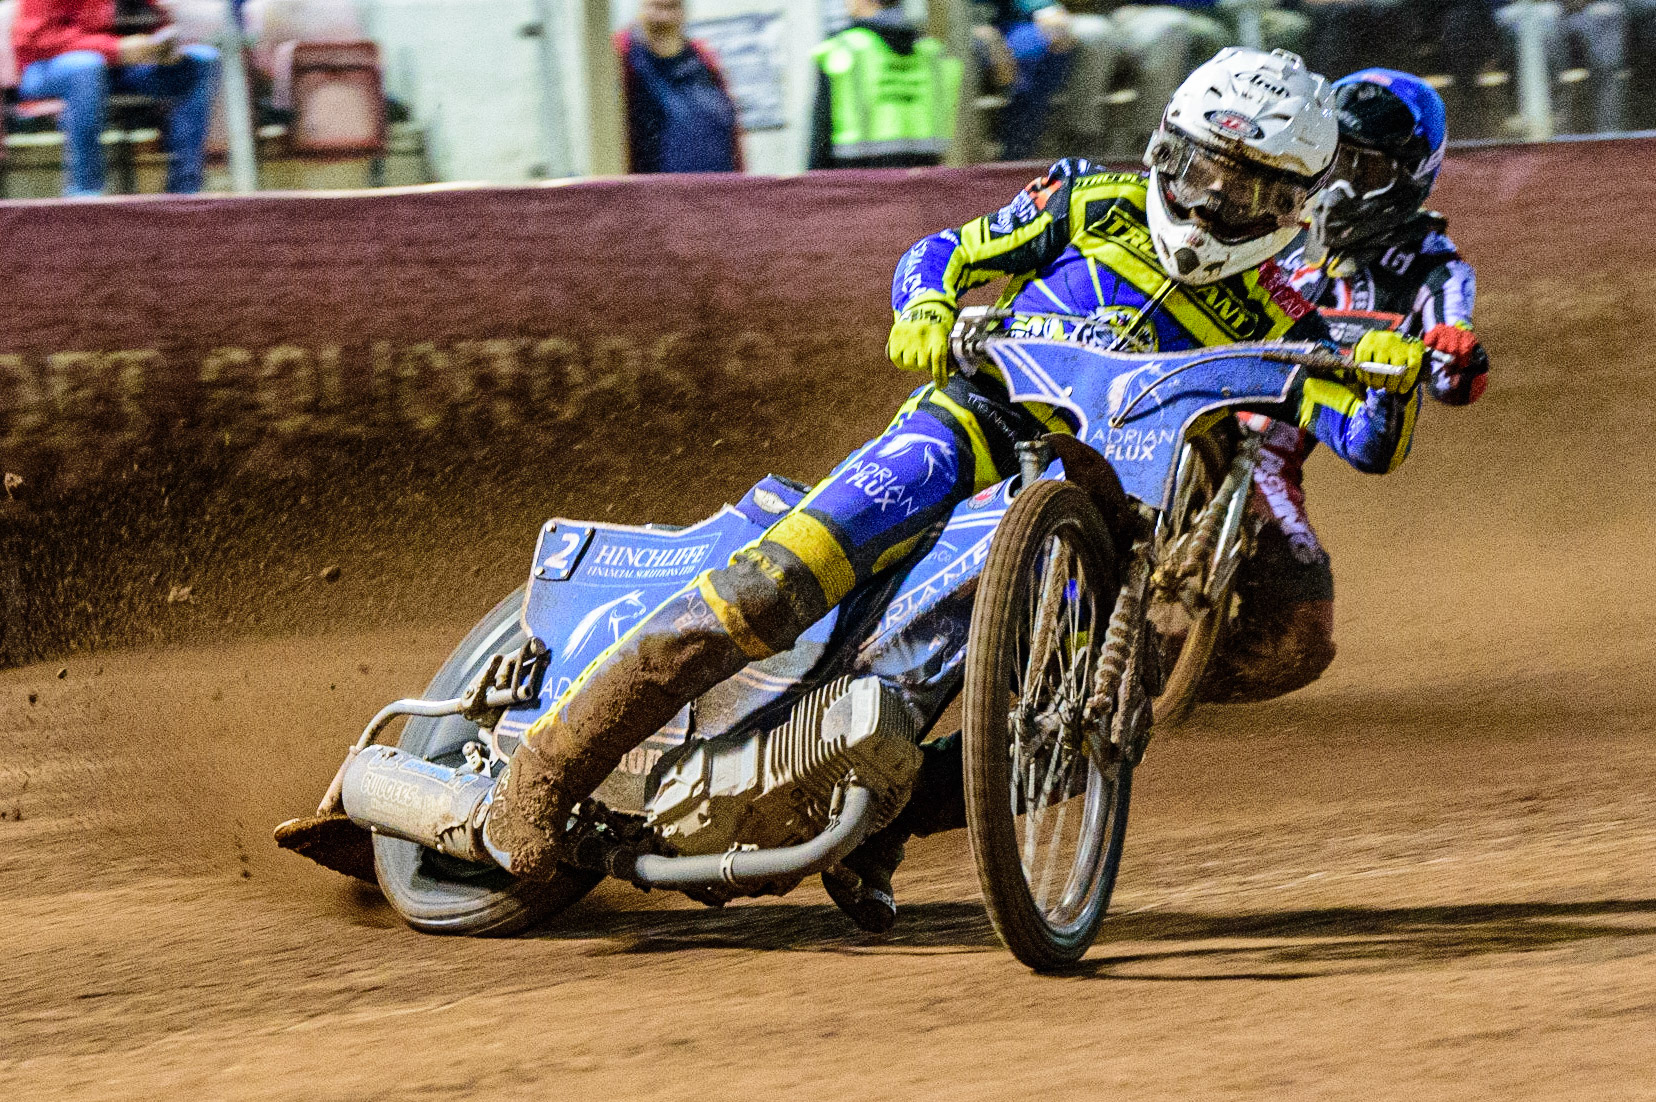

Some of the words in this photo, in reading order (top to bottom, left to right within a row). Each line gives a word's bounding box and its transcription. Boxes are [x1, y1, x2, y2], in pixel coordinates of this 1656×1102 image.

[1089, 428, 1176, 445] ADRIAN
[1104, 442, 1156, 461] FLUX
[845, 472, 897, 512] FLUX
[846, 460, 920, 516] ADRIAN
[543, 532, 580, 570] 2
[593, 543, 710, 568] HINCHLIFFE
[587, 566, 634, 579] FINANCIAL
